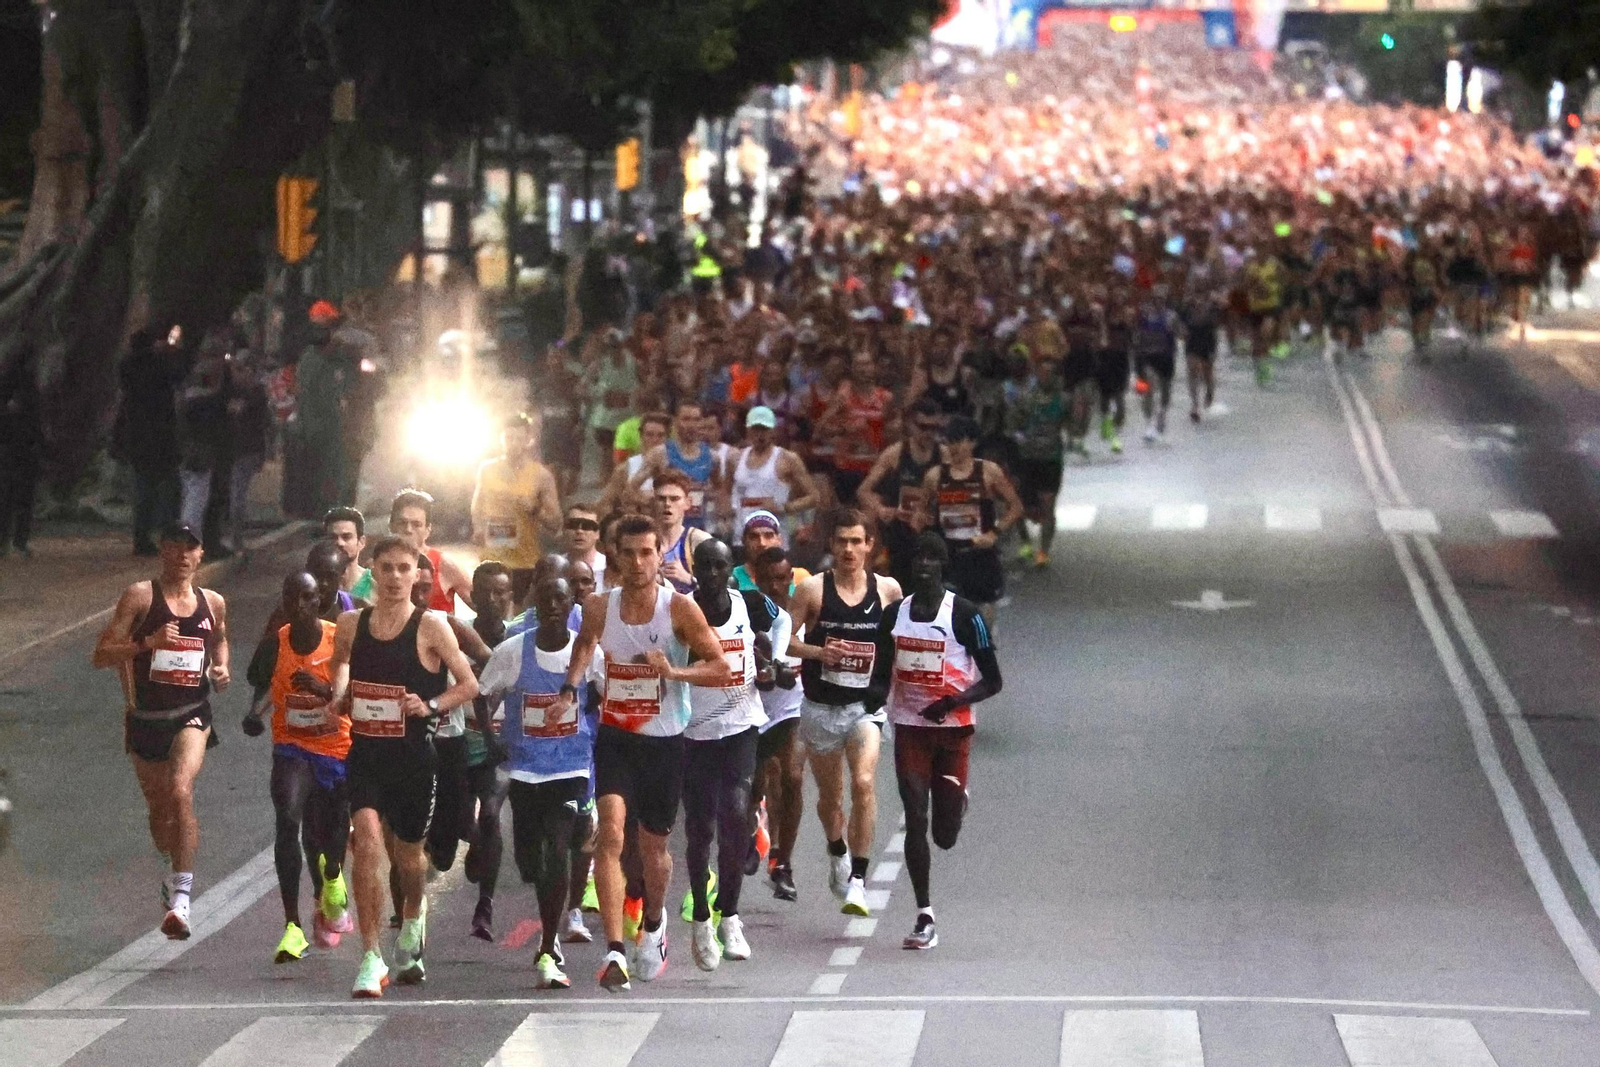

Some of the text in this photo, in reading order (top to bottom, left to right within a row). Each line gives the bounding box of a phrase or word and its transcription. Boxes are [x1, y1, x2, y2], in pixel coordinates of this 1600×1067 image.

[843, 622, 880, 630] RUNNIN
[839, 657, 863, 668] 4541
[363, 685, 400, 696] GENERALI
